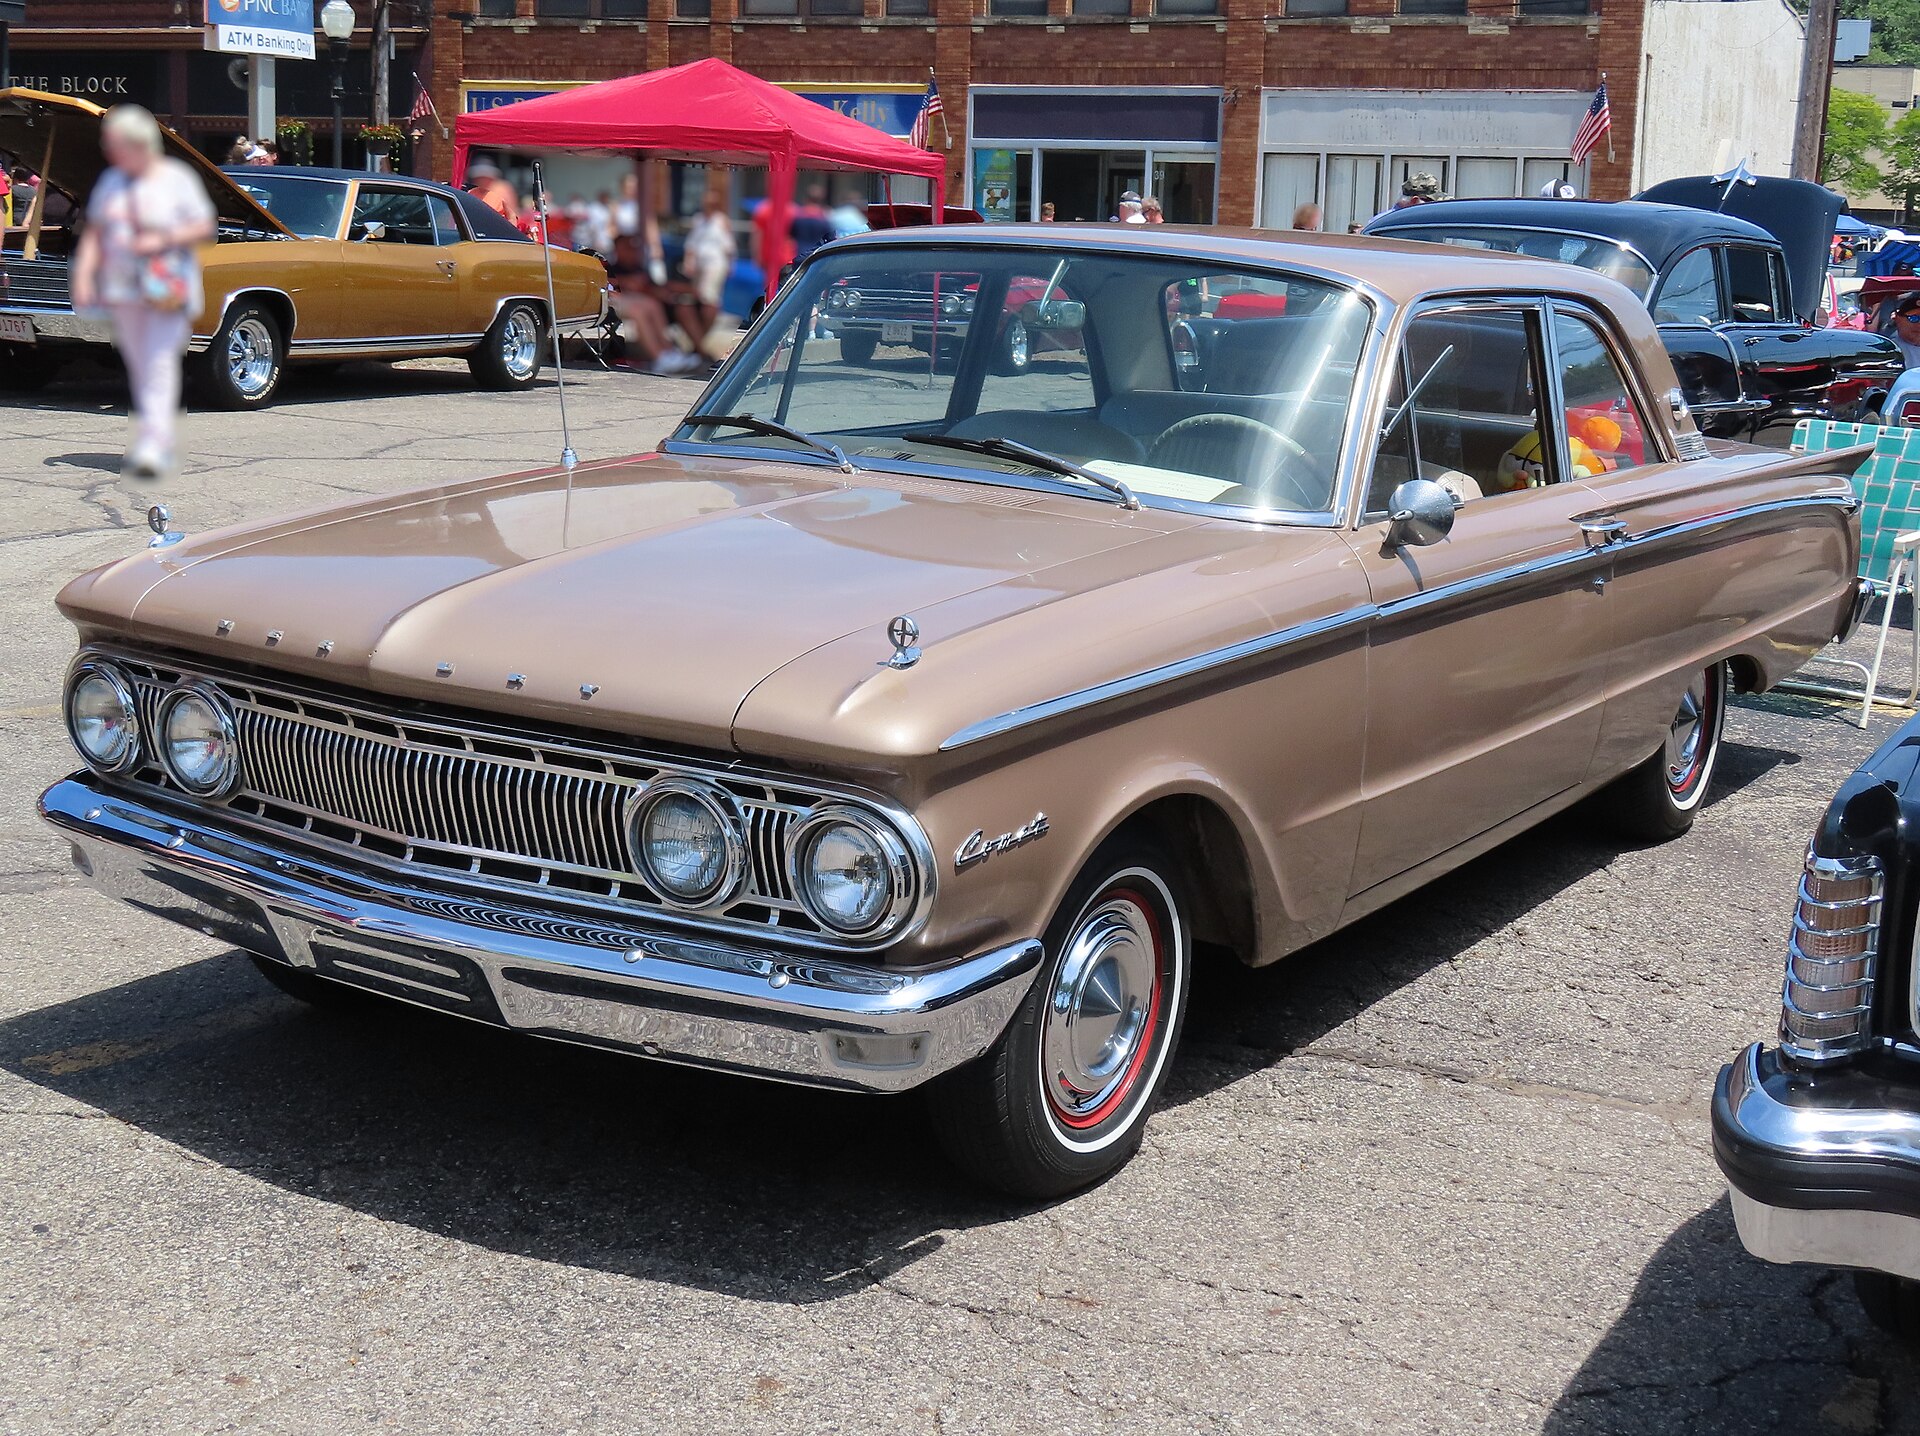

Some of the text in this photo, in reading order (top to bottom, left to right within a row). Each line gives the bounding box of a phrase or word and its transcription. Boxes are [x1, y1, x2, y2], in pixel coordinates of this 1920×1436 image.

[227, 32, 311, 56] ATM Banking Only
[8, 76, 128, 94] THE BLOCK
[832, 99, 892, 130] Kelly
[1154, 170, 1165, 180] 39
[0, 319, 26, 333] 176F
[953, 811, 1050, 867] Comet
